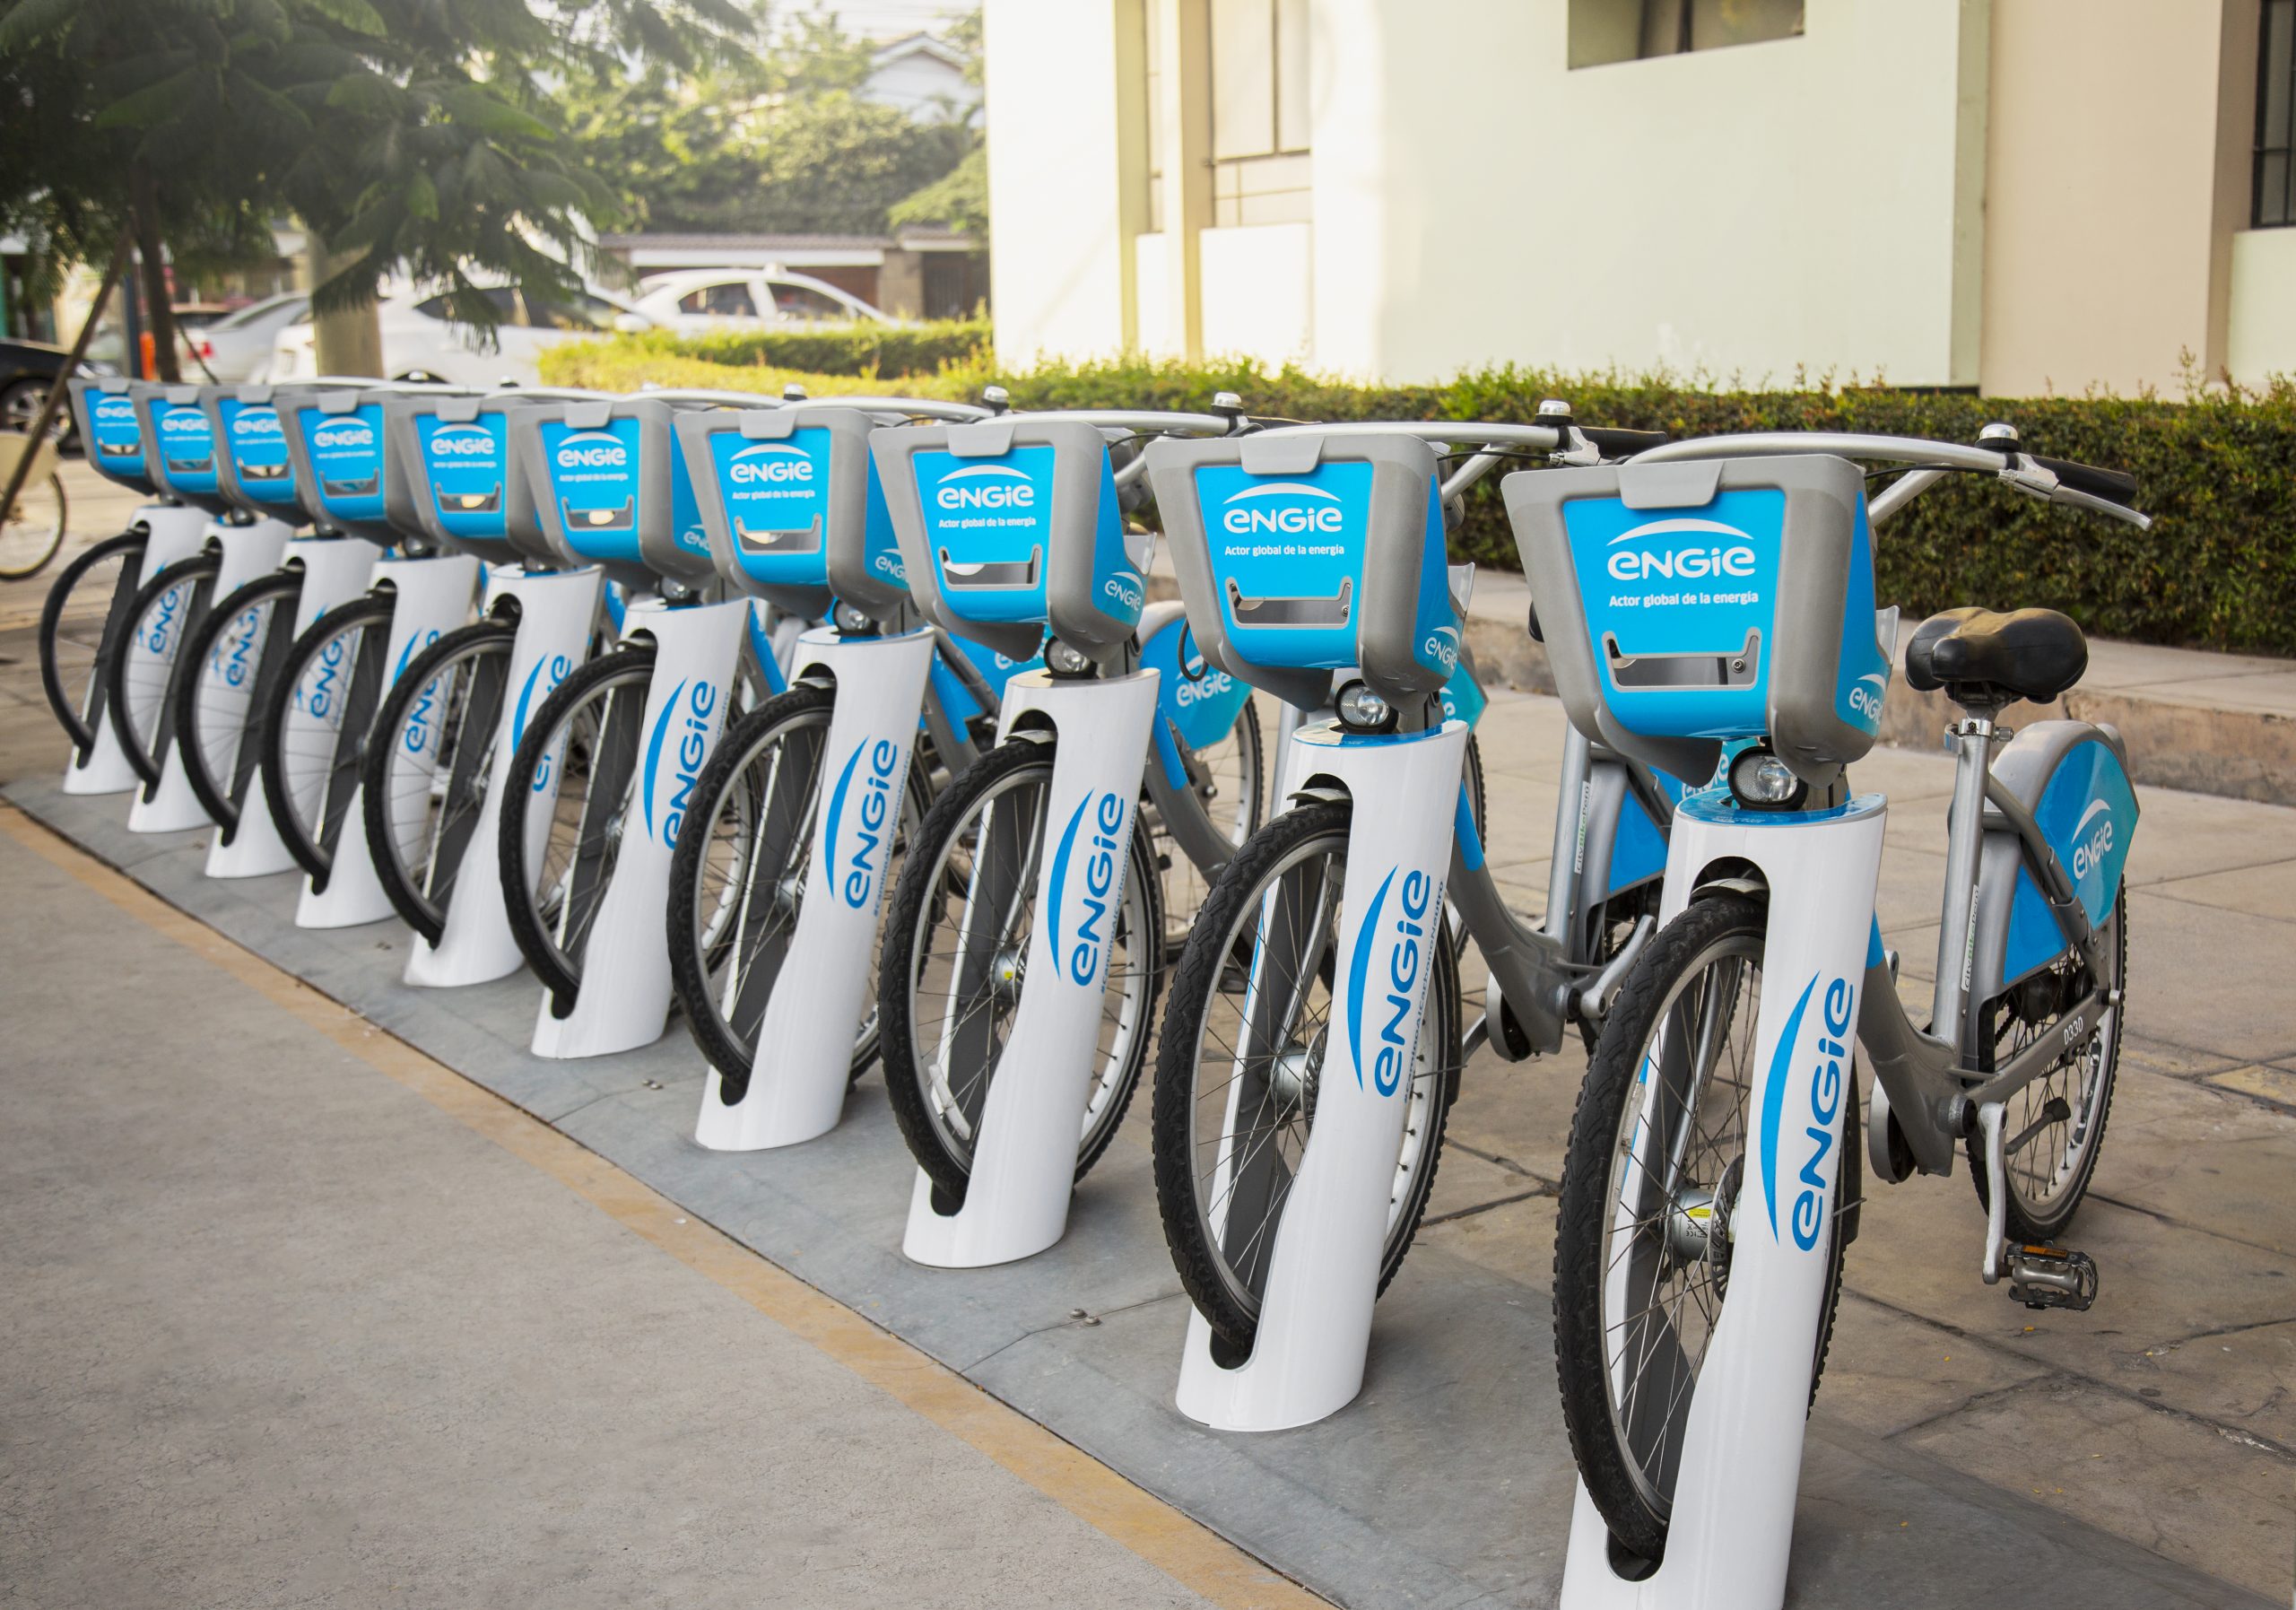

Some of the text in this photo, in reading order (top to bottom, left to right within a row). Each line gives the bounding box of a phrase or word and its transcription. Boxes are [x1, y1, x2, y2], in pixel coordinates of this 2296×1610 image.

[938, 518, 960, 528] Actor
[961, 518, 986, 529] global
[987, 518, 996, 527] de
[997, 517, 1005, 527] la
[1224, 544, 1250, 555] Actor
[1252, 544, 1282, 557] global
[1283, 544, 1296, 555] de
[1298, 544, 1306, 554] la
[1609, 589, 1759, 608] Actor global de la energía
